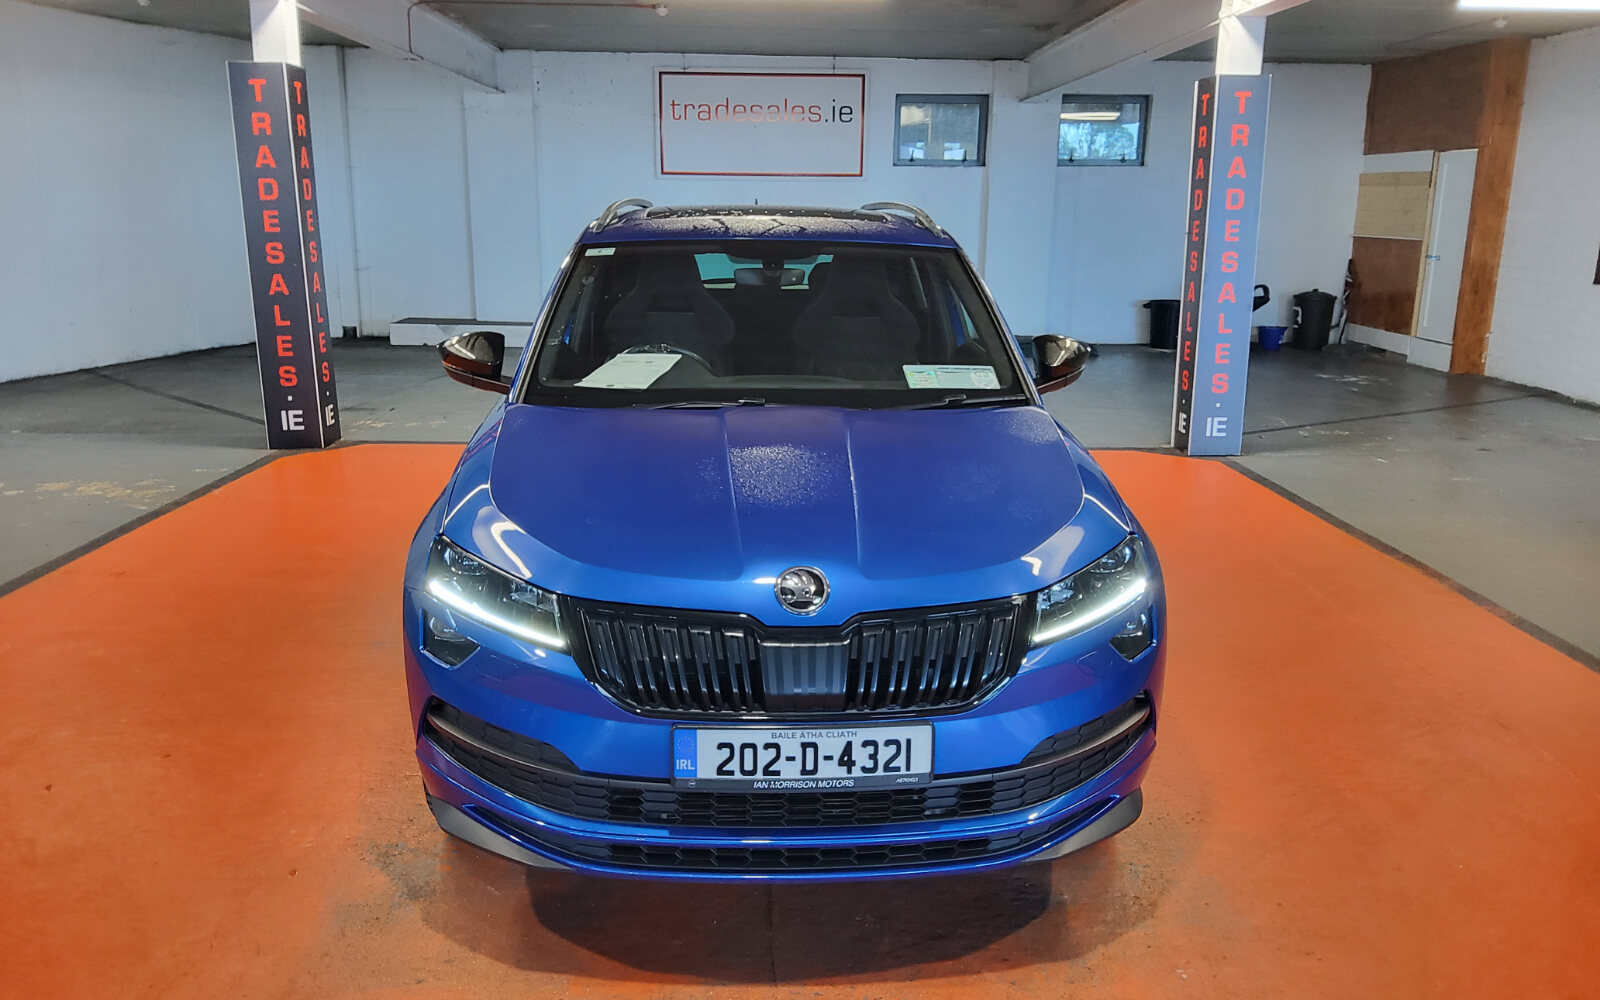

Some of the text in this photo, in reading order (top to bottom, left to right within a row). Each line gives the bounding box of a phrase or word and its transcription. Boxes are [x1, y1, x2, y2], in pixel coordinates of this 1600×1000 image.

[670, 97, 854, 124] tradesales.ie
[826, 730, 858, 738] CLIATH
[716, 738, 912, 777] 202-D-4321
[676, 759, 695, 770] IRL
[753, 779, 855, 789] IAN MORRISON MOTORS
